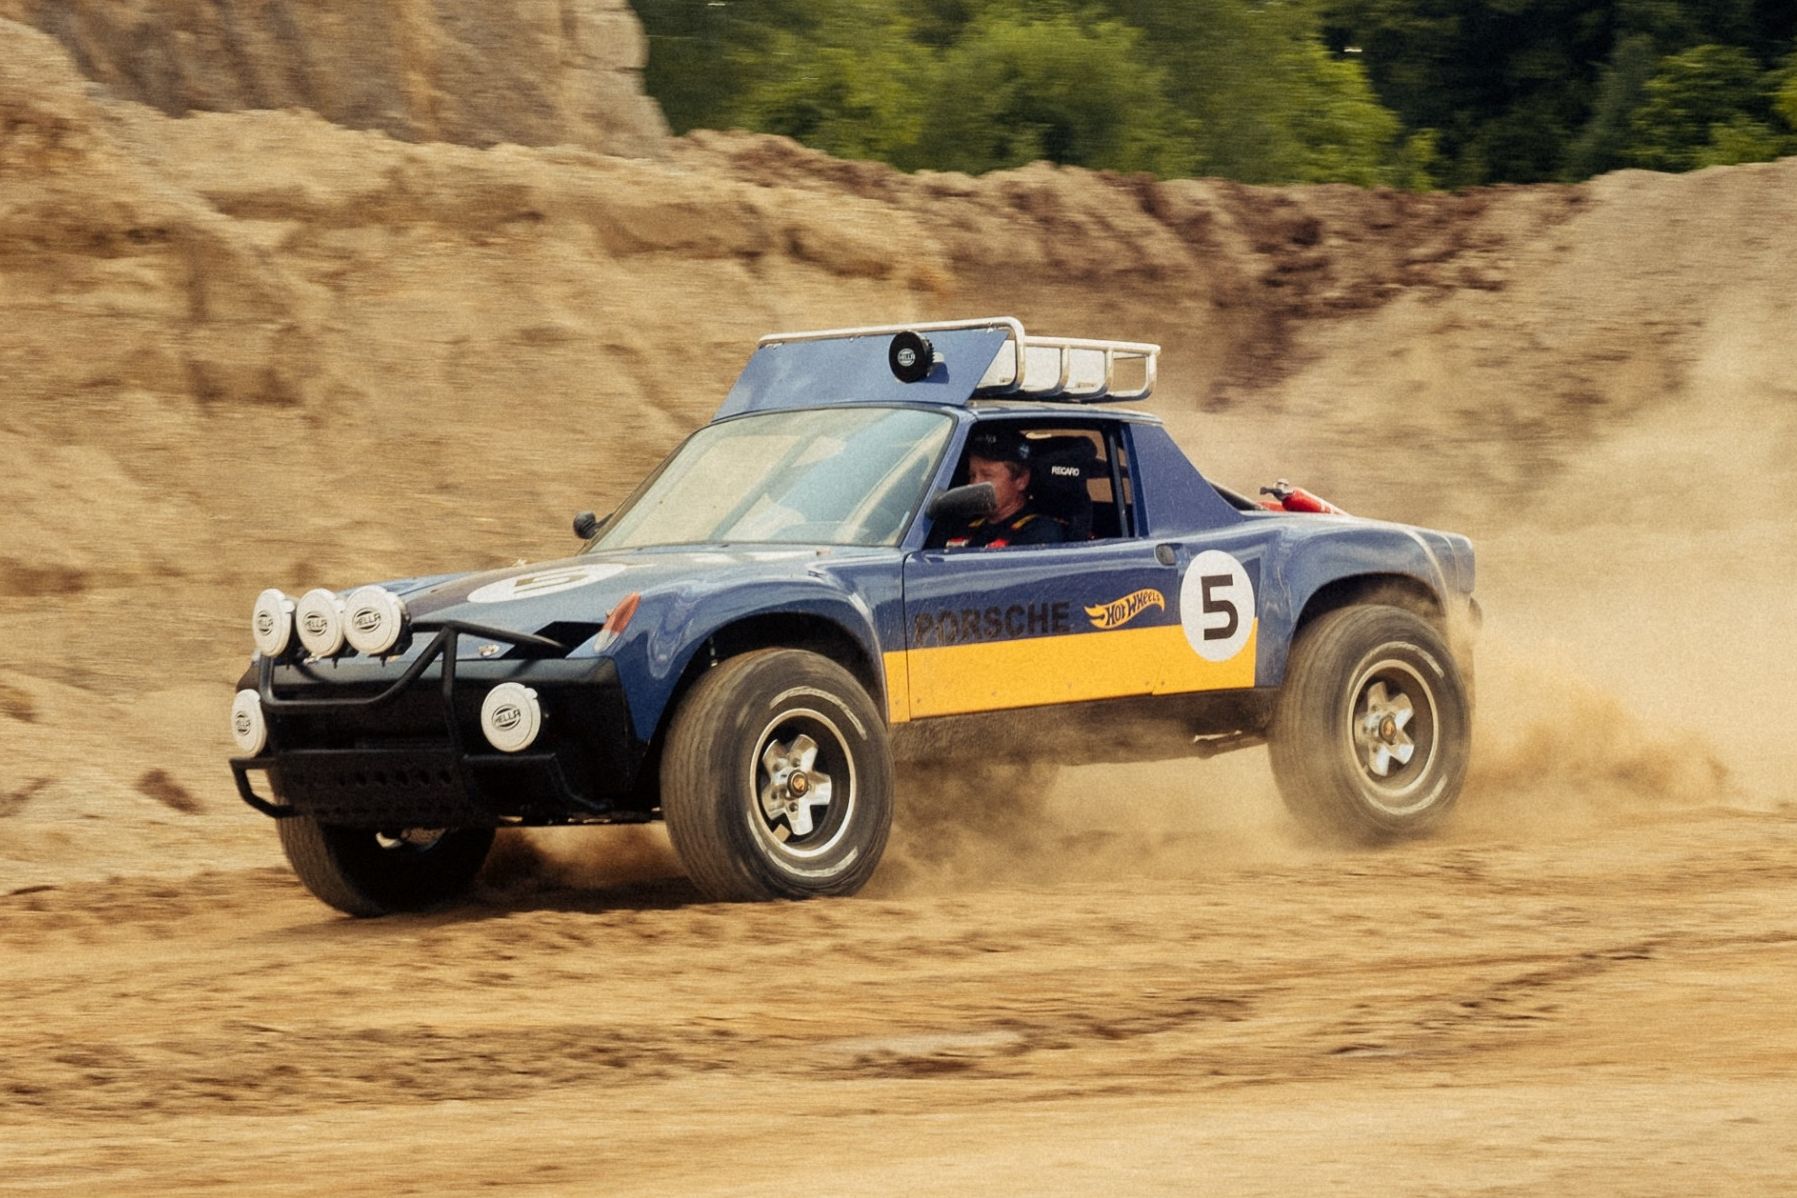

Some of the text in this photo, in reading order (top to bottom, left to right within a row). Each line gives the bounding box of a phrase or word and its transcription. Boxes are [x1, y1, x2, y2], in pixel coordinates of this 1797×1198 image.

[1051, 465, 1080, 477] RECARO
[914, 601, 1071, 646] PORSCHE
[1200, 574, 1238, 641] 5
